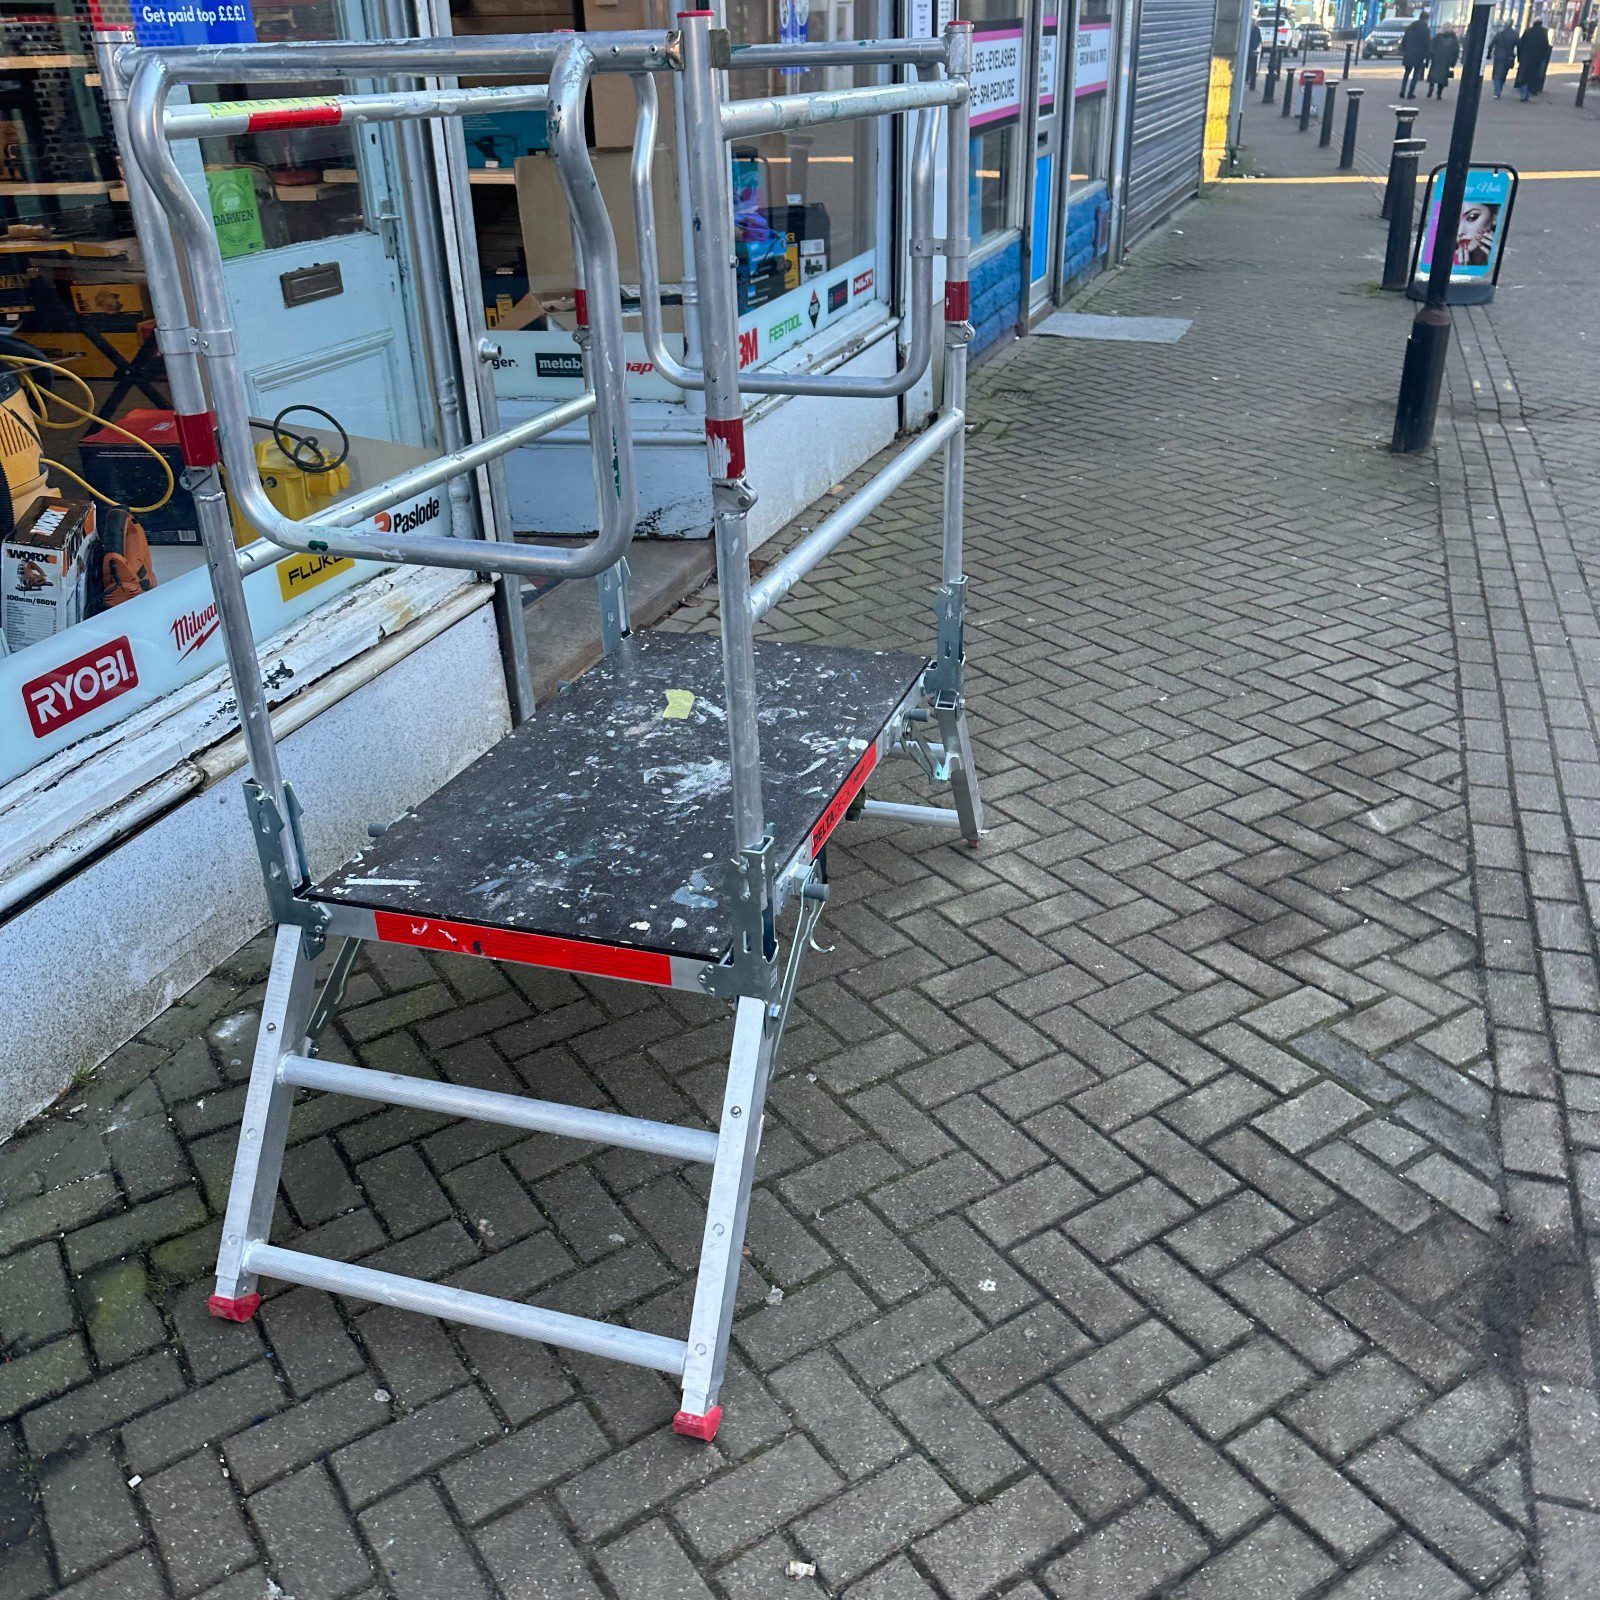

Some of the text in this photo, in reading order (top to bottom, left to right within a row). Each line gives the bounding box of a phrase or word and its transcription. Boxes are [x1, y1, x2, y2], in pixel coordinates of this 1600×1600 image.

[142, 4, 246, 27] Get paid top £££!
[212, 209, 254, 227] DARWEN
[768, 313, 803, 343] FESTOOL
[539, 357, 584, 370] metab
[738, 327, 758, 370] 3M
[394, 497, 439, 534] Paslode
[8, 549, 50, 563] WORX
[169, 602, 218, 651] Milwa
[31, 650, 129, 725] RYOBI
